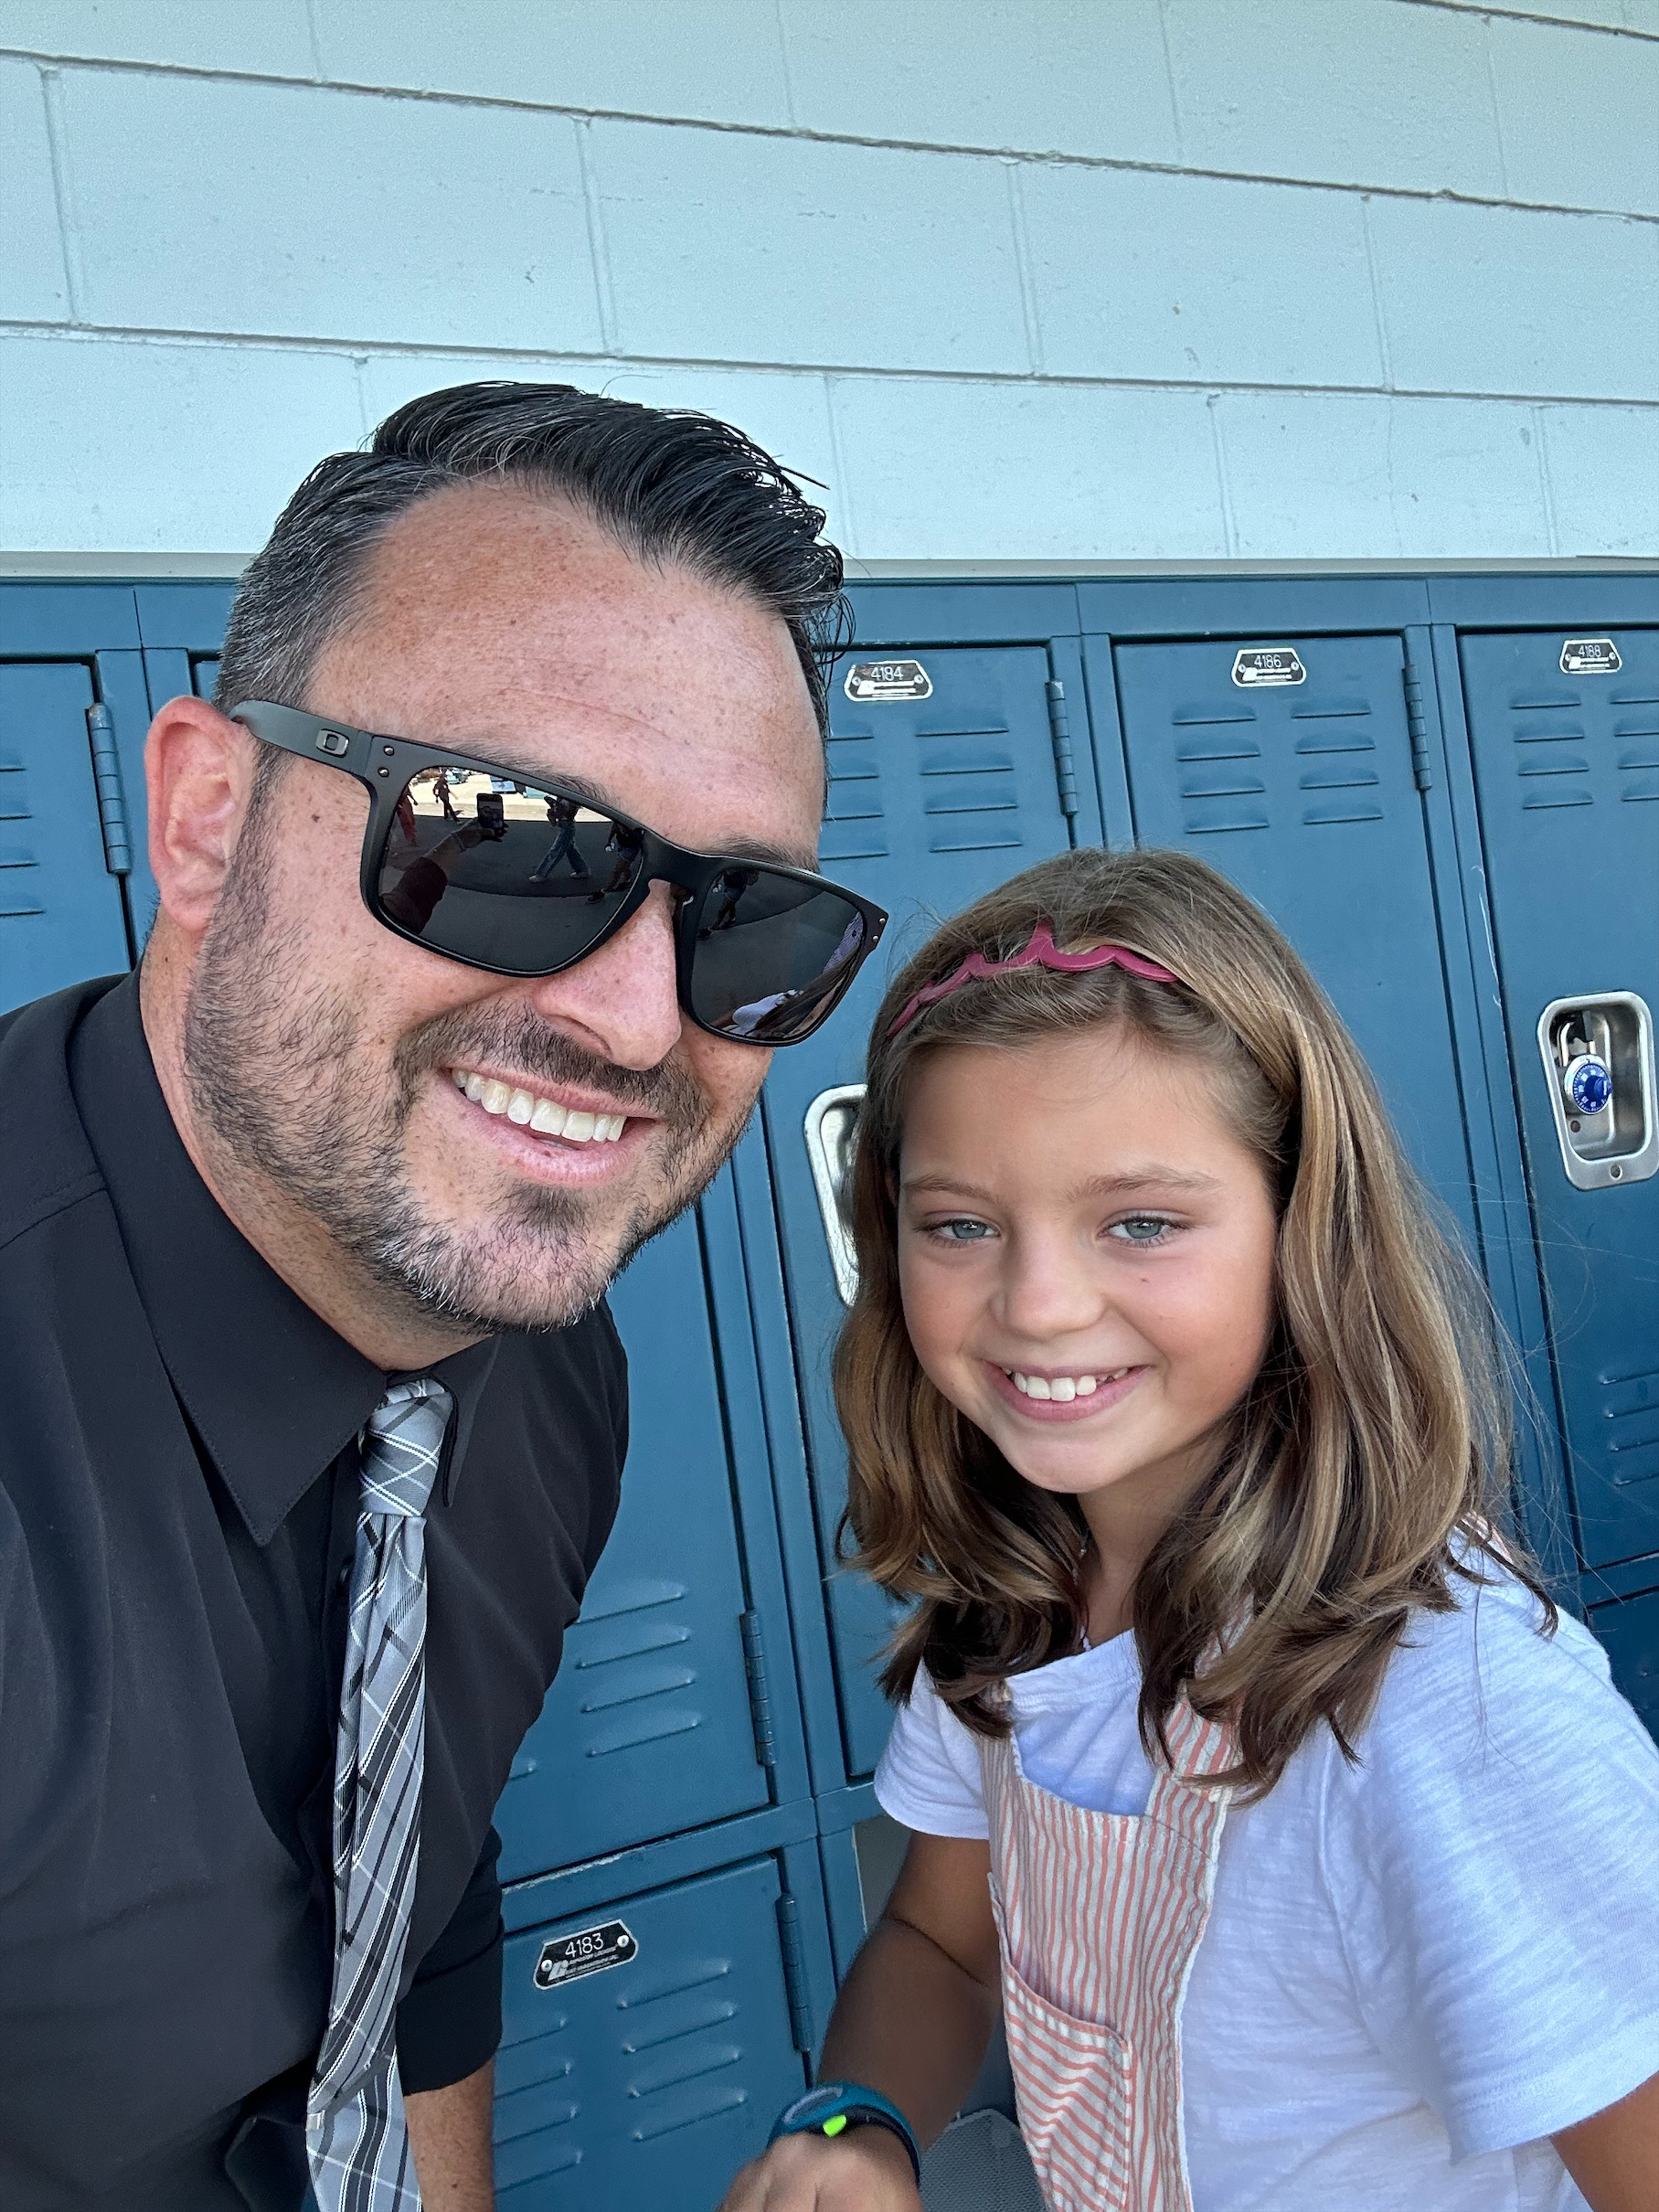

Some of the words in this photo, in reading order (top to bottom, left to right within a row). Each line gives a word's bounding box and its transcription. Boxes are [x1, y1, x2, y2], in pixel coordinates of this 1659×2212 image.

[1578, 644, 1601, 657] 4188
[1254, 654, 1281, 668] 4186
[871, 666, 903, 681] 4184
[565, 1932, 604, 1958] 4183
